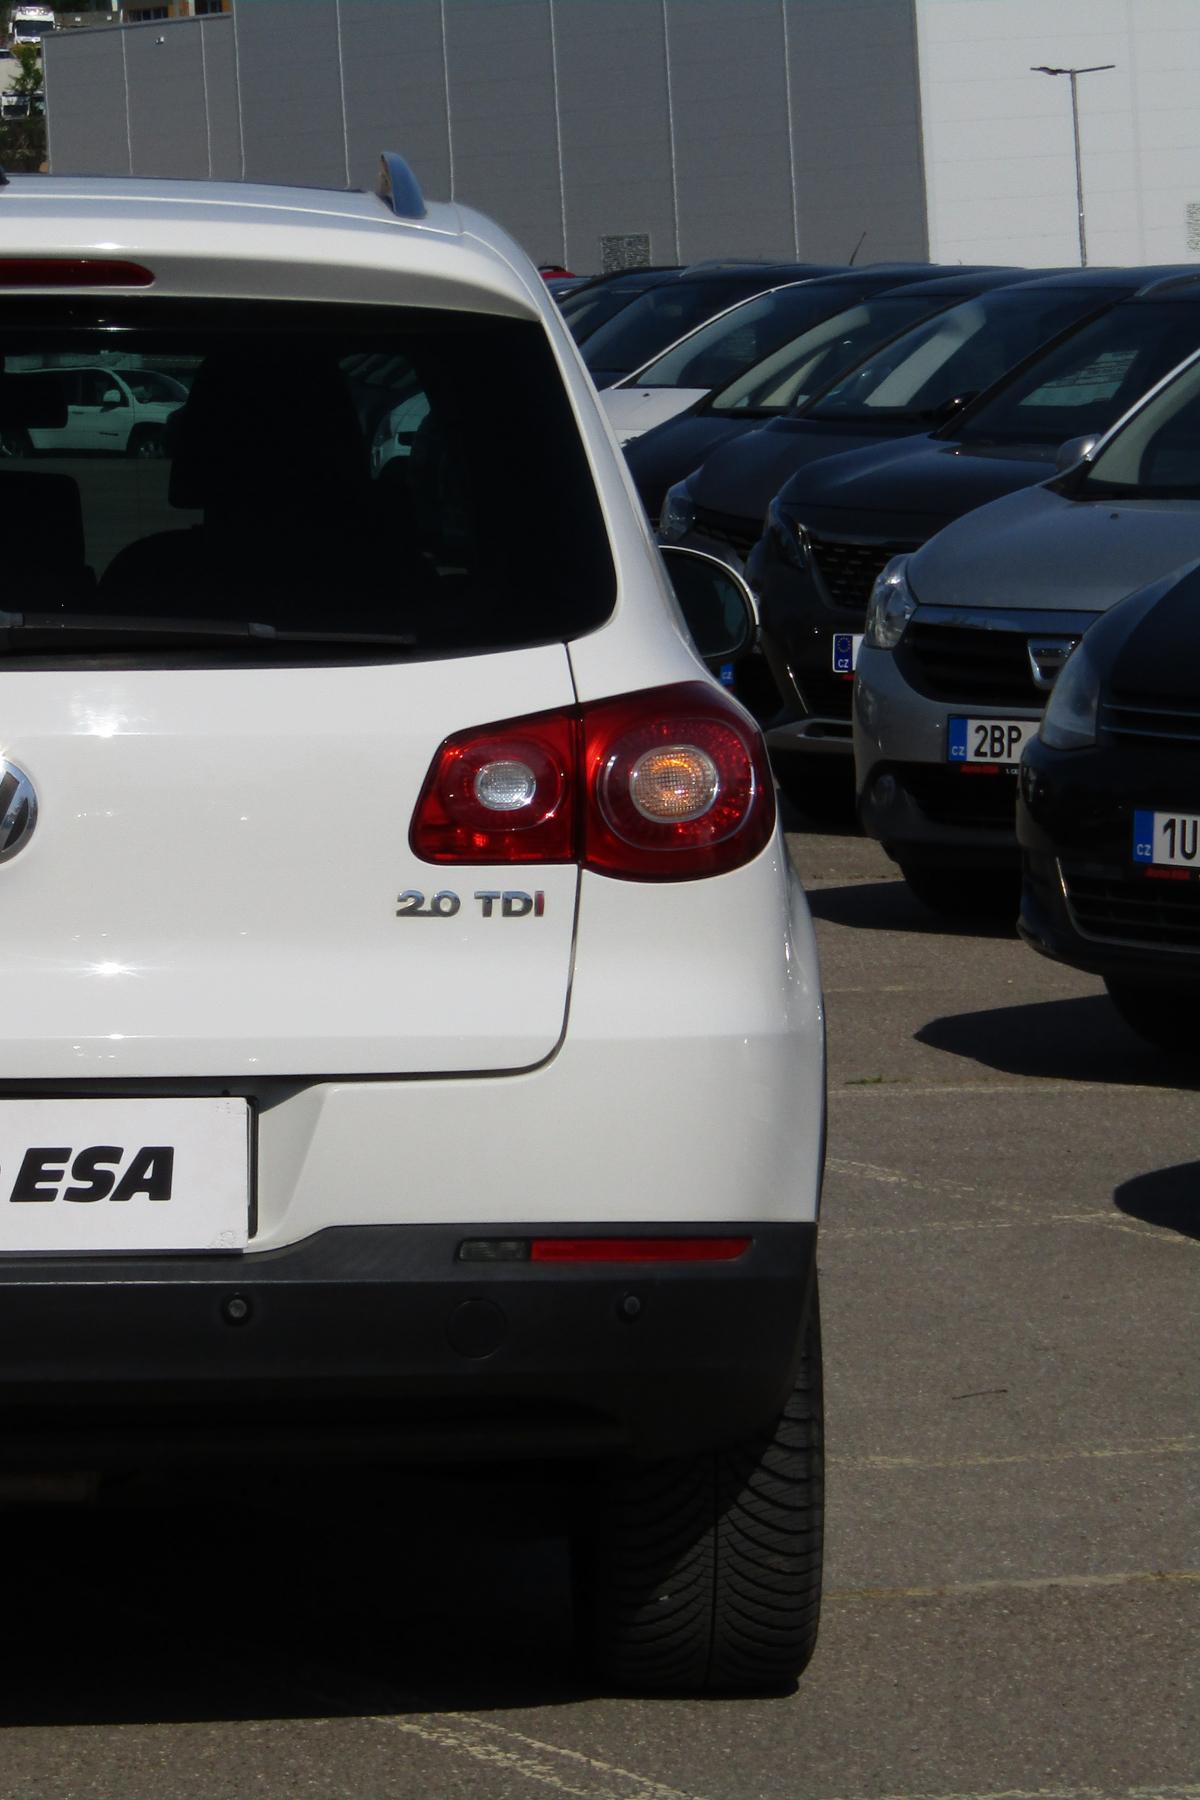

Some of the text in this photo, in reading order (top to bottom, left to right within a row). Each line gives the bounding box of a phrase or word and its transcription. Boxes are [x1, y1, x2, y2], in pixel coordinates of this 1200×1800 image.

[837, 658, 850, 669] CZ
[951, 724, 1022, 758] CZ 2BP
[1136, 818, 1199, 861] CZ 1U
[474, 890, 545, 918] TDI
[8, 1145, 175, 1204] ESA
